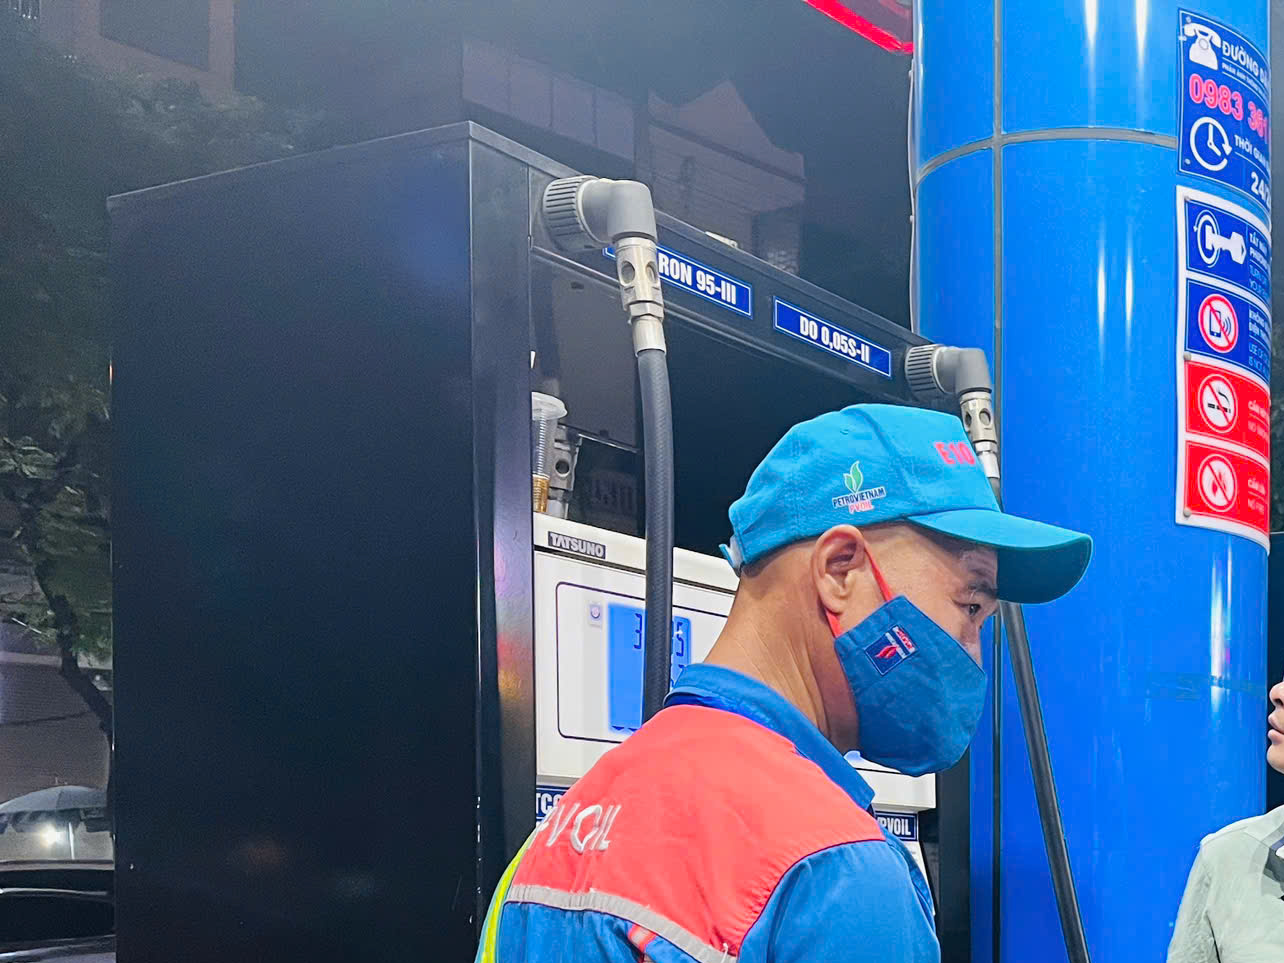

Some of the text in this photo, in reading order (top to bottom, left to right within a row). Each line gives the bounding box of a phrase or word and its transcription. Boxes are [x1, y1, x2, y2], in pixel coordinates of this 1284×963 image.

[1189, 73, 1244, 121] 0983
[1234, 134, 1253, 155] THỜI
[658, 253, 736, 305] RON 95-III
[800, 316, 870, 364] DO 0,05S-II
[832, 487, 885, 508] PETROVIETNAM
[550, 533, 604, 558] TATSUNO
